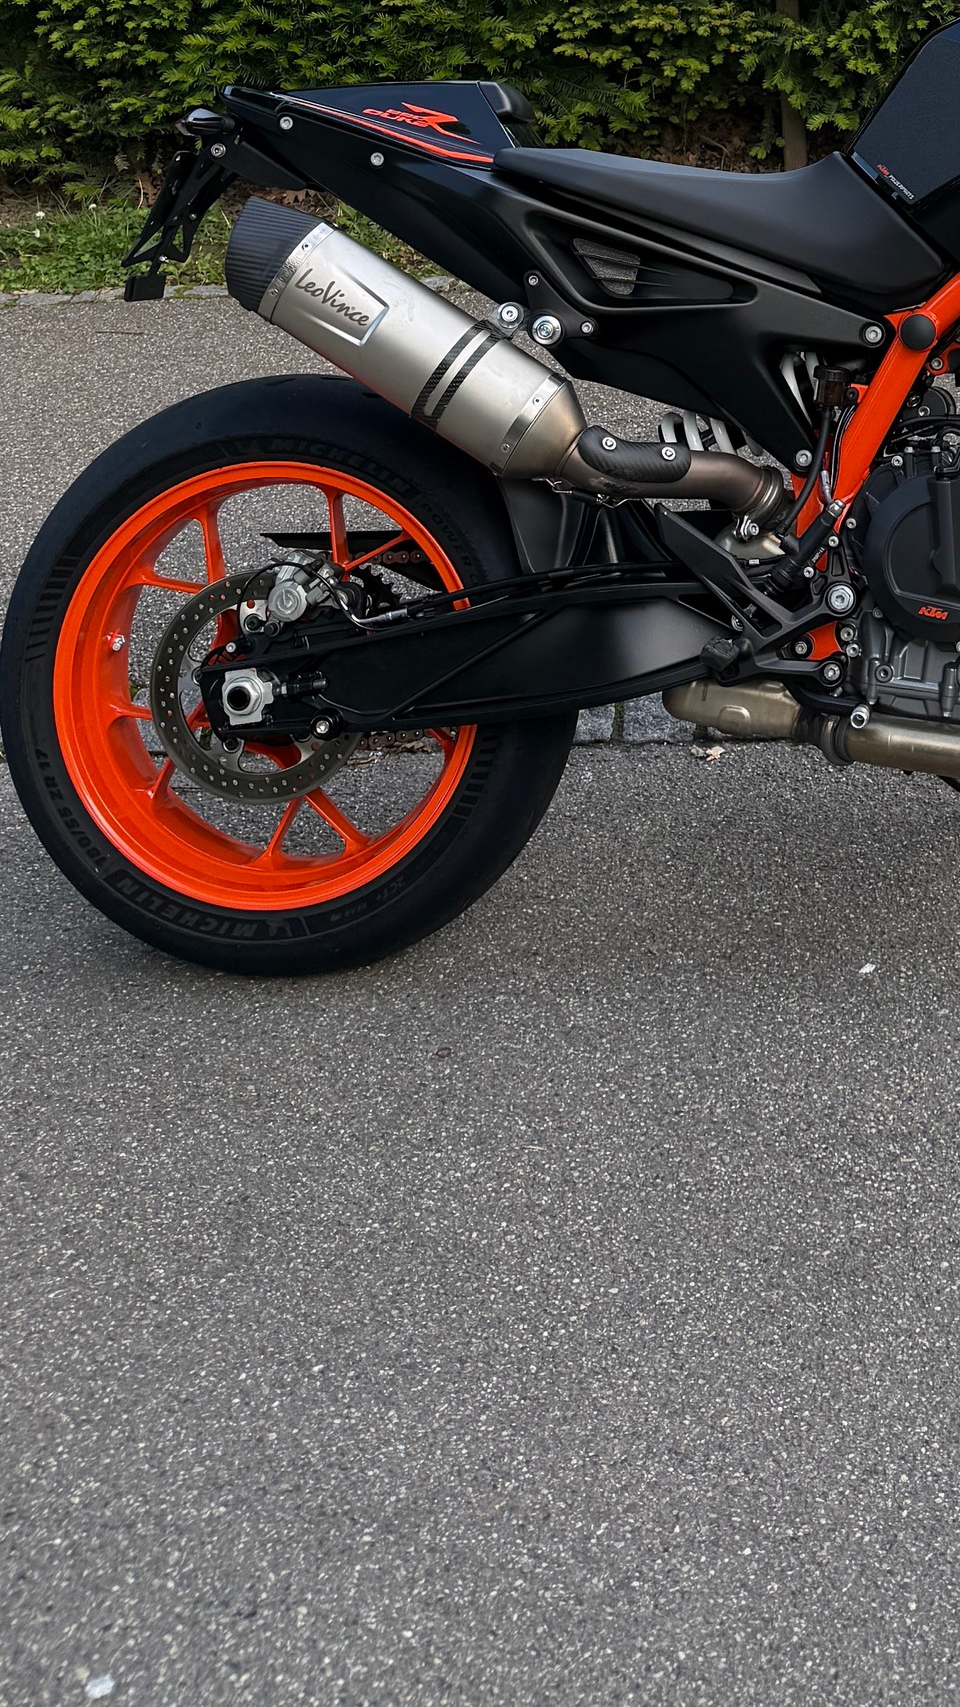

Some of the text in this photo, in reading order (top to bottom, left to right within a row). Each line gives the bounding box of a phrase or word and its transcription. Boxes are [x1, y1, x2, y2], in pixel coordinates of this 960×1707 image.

[294, 268, 370, 326] LeoVince
[271, 436, 414, 494] MICHELIN
[918, 605, 949, 620] KTM
[34, 747, 51, 769] 17
[44, 775, 64, 801] ZR
[115, 874, 258, 939] MICHELIN
